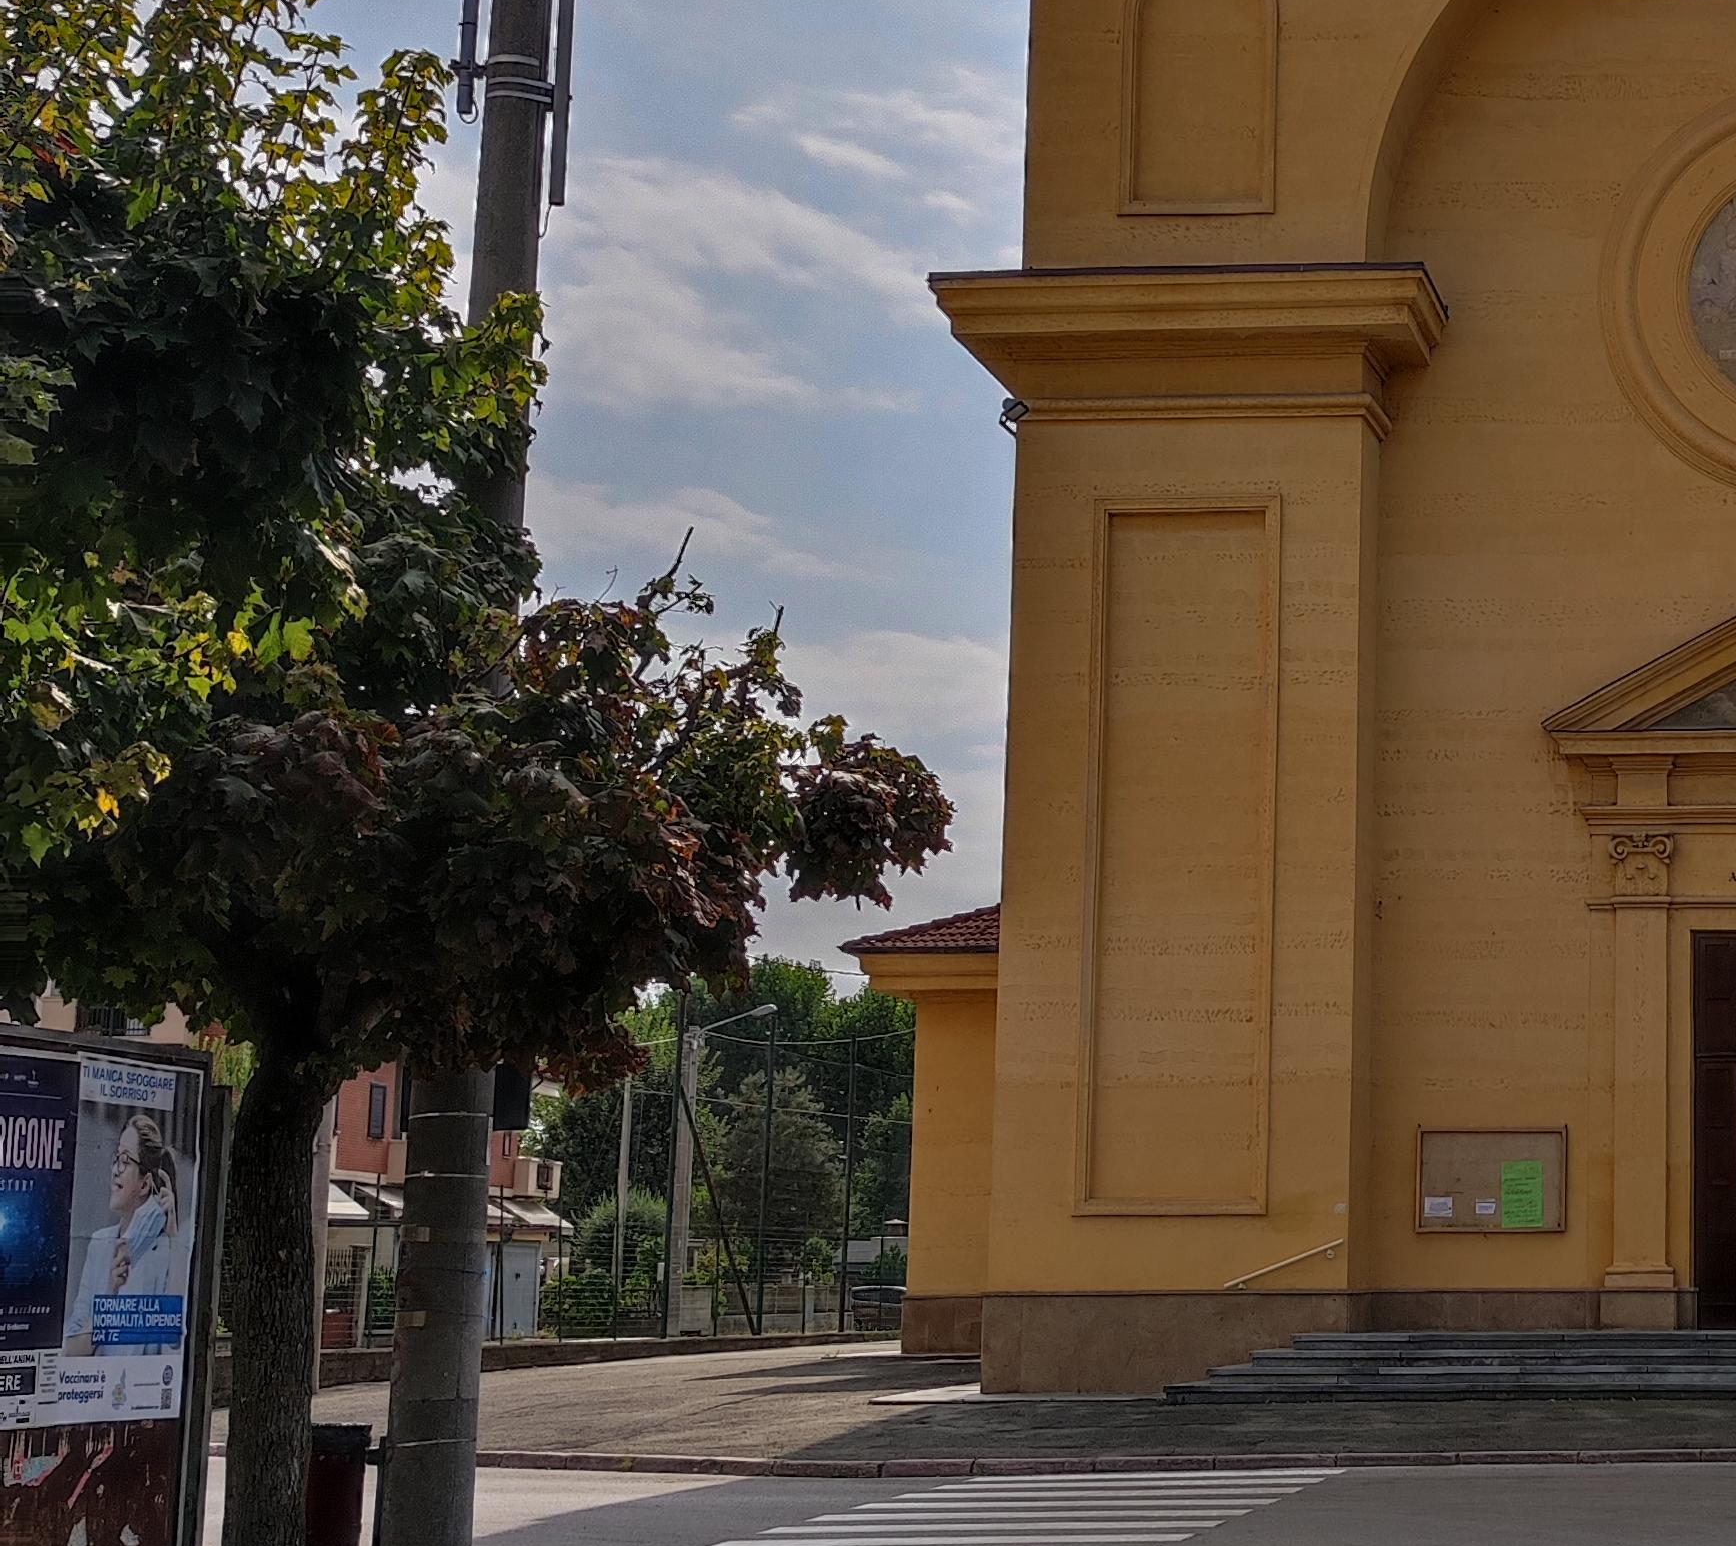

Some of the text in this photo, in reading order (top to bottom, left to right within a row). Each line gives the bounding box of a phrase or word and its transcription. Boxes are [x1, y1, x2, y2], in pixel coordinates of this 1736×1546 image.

[82, 1065, 175, 1091] TI MANCA SFOGGIARE
[100, 1083, 107, 1097] IL
[109, 1085, 149, 1102] SORRISO
[94, 1298, 160, 1312] TORNARE ALLA
[93, 1312, 182, 1328] NORMALITÀ DIPENDE
[92, 1329, 120, 1342] DA TE
[59, 1370, 99, 1384] Vaccinarsi
[57, 1387, 104, 1403] proteggersi
